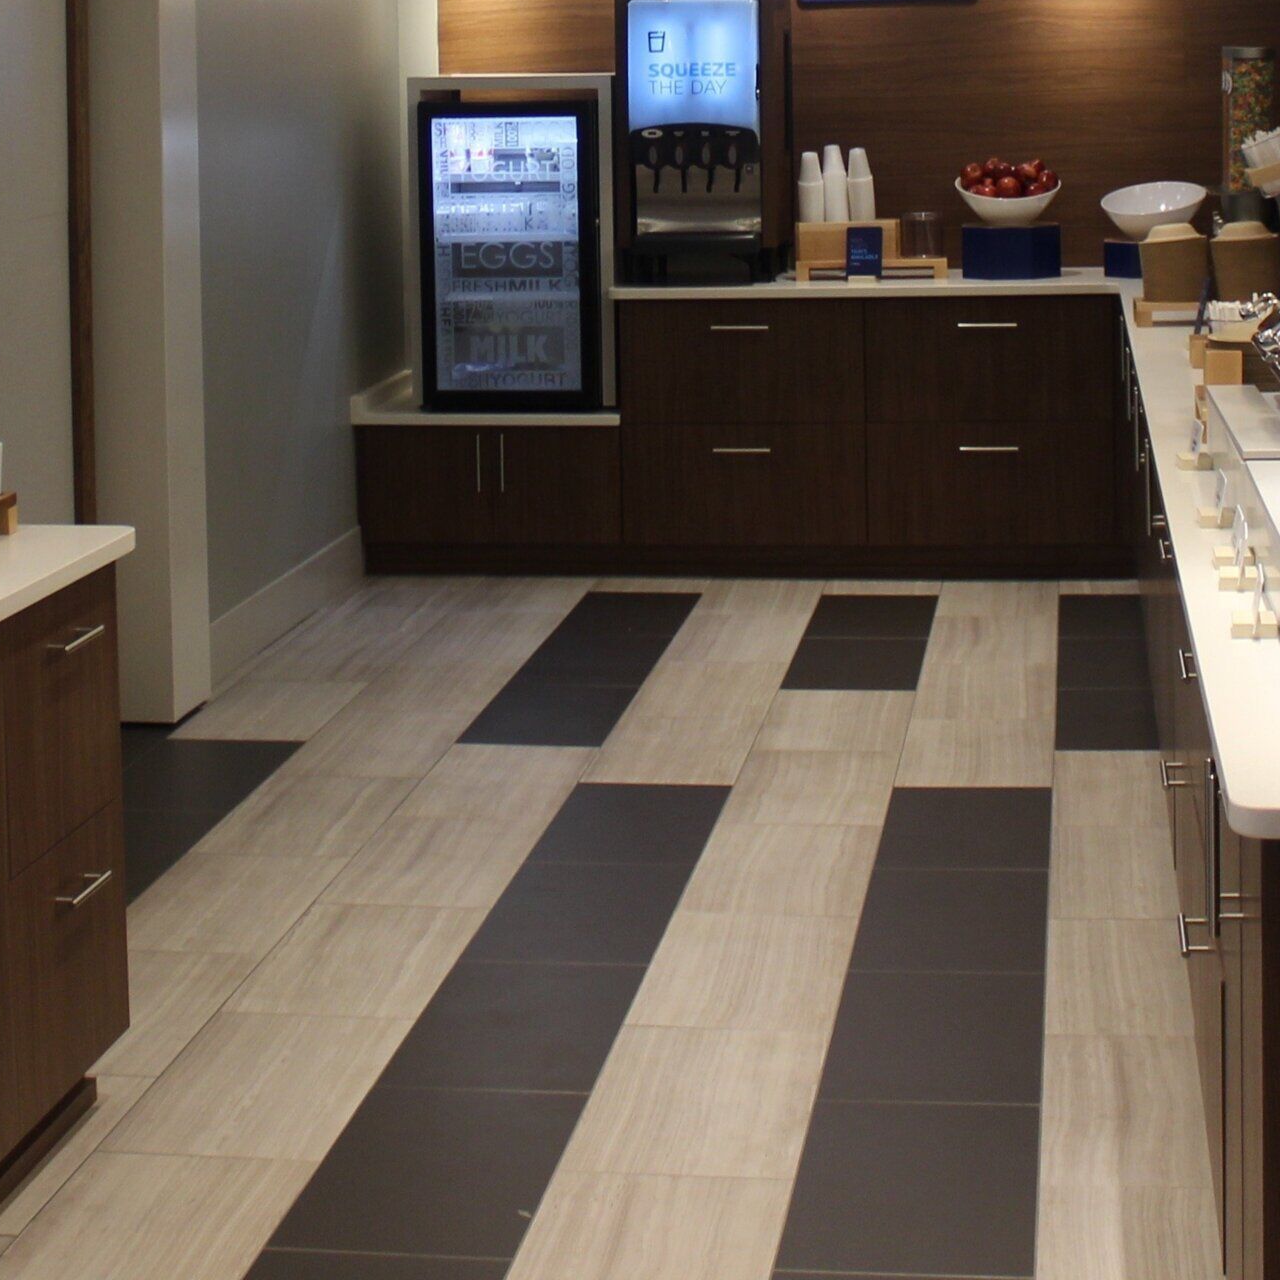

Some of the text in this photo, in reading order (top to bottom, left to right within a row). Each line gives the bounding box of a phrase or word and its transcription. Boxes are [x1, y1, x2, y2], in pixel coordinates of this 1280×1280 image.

[648, 62, 737, 79] SQUEEZE
[648, 79, 728, 96] THE DAY
[461, 241, 554, 270] EGGS
[471, 333, 549, 366] MILK
